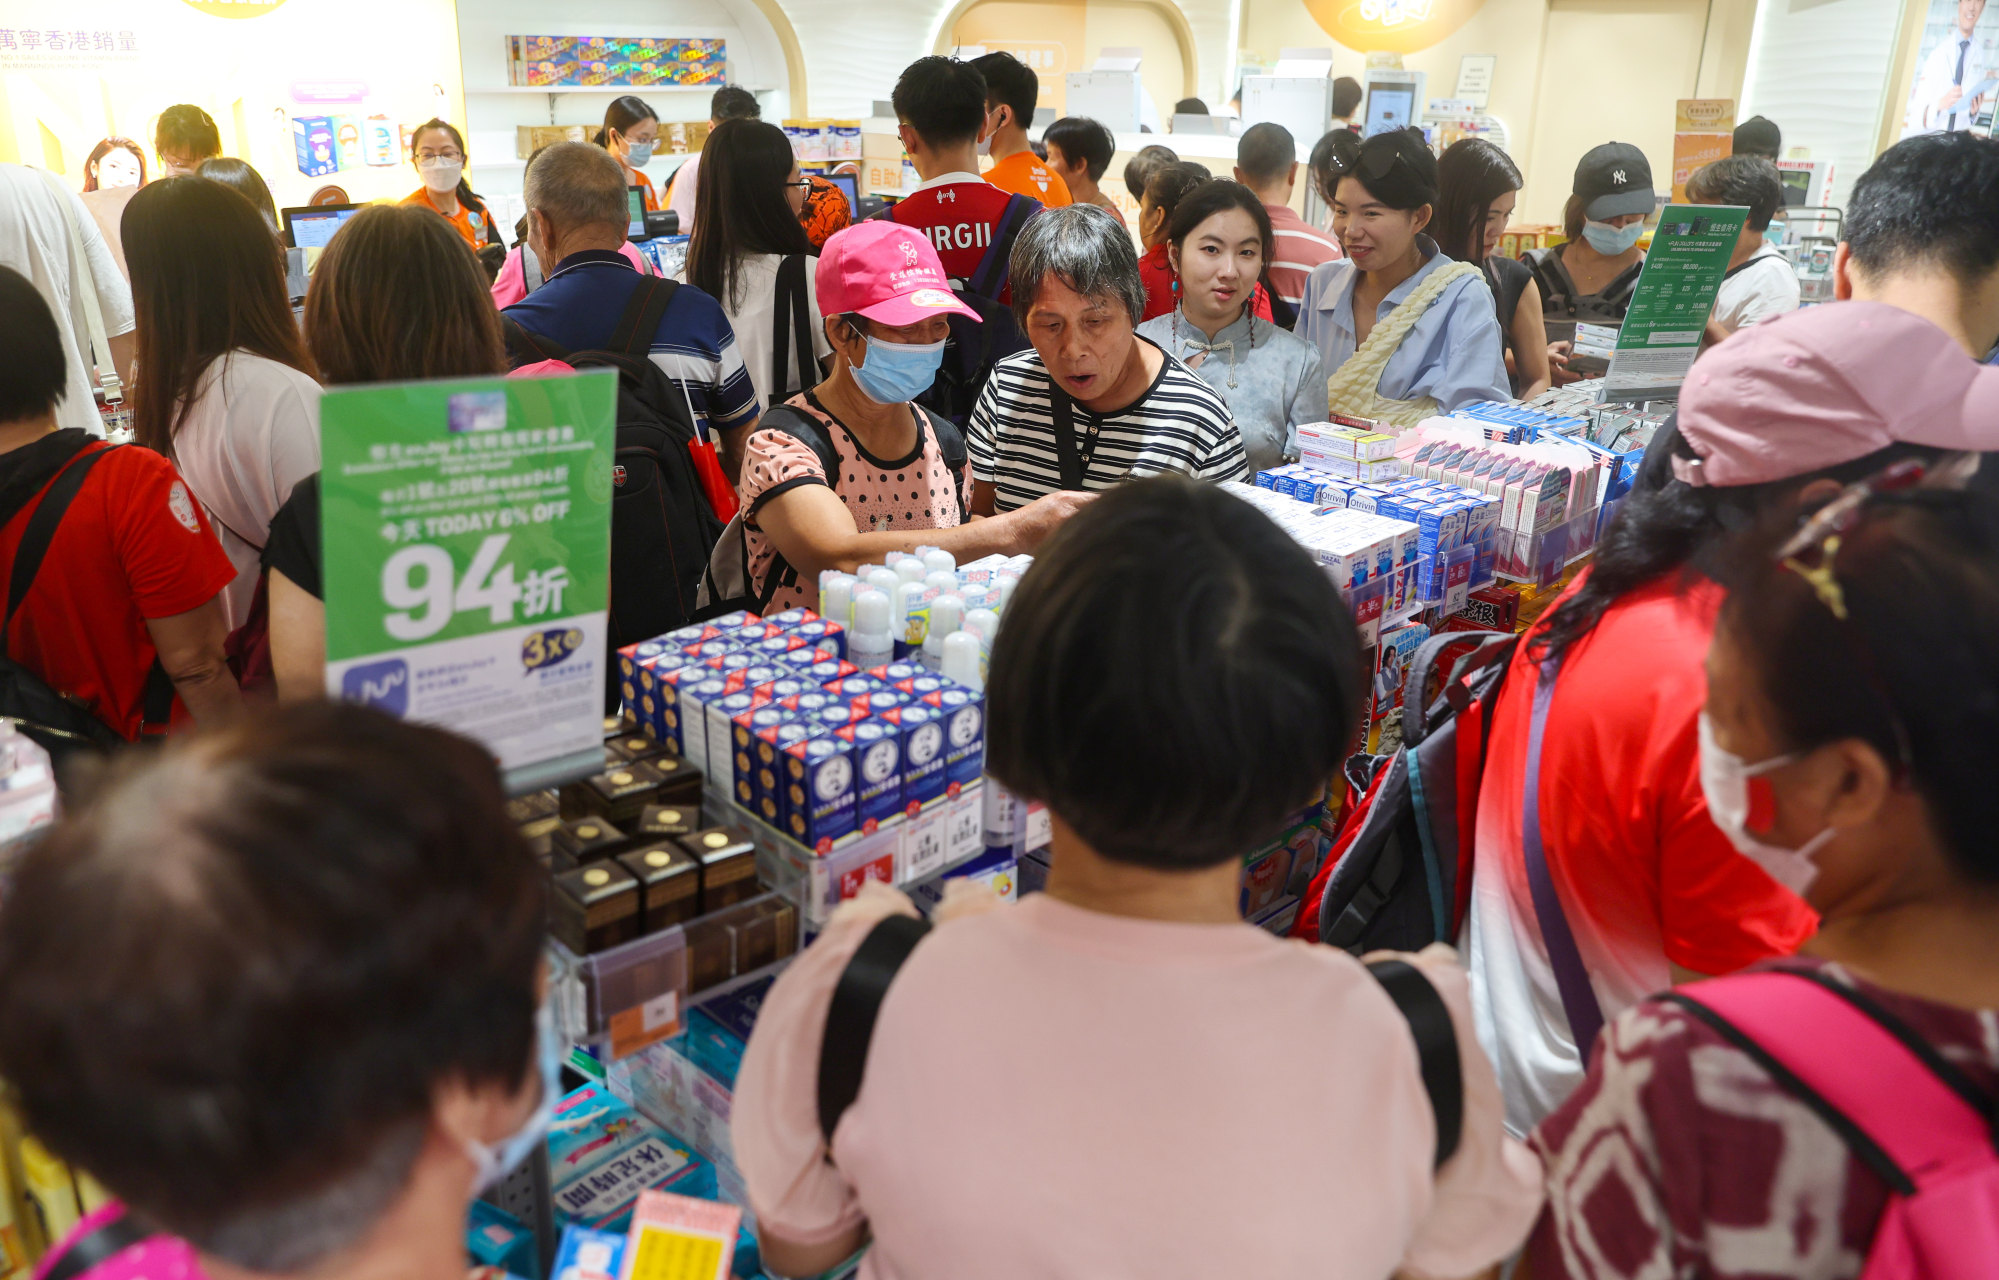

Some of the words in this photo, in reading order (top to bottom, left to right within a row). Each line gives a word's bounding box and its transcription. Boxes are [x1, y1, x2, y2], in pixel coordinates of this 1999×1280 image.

[871, 168, 903, 188] 自助
[1613, 169, 1627, 184] NY
[1321, 491, 1346, 505] Otrivin
[1350, 498, 1376, 512] Otrivin
[425, 510, 497, 538] TODAY
[531, 499, 572, 523] OFF
[1321, 553, 1342, 565] NAZAL
